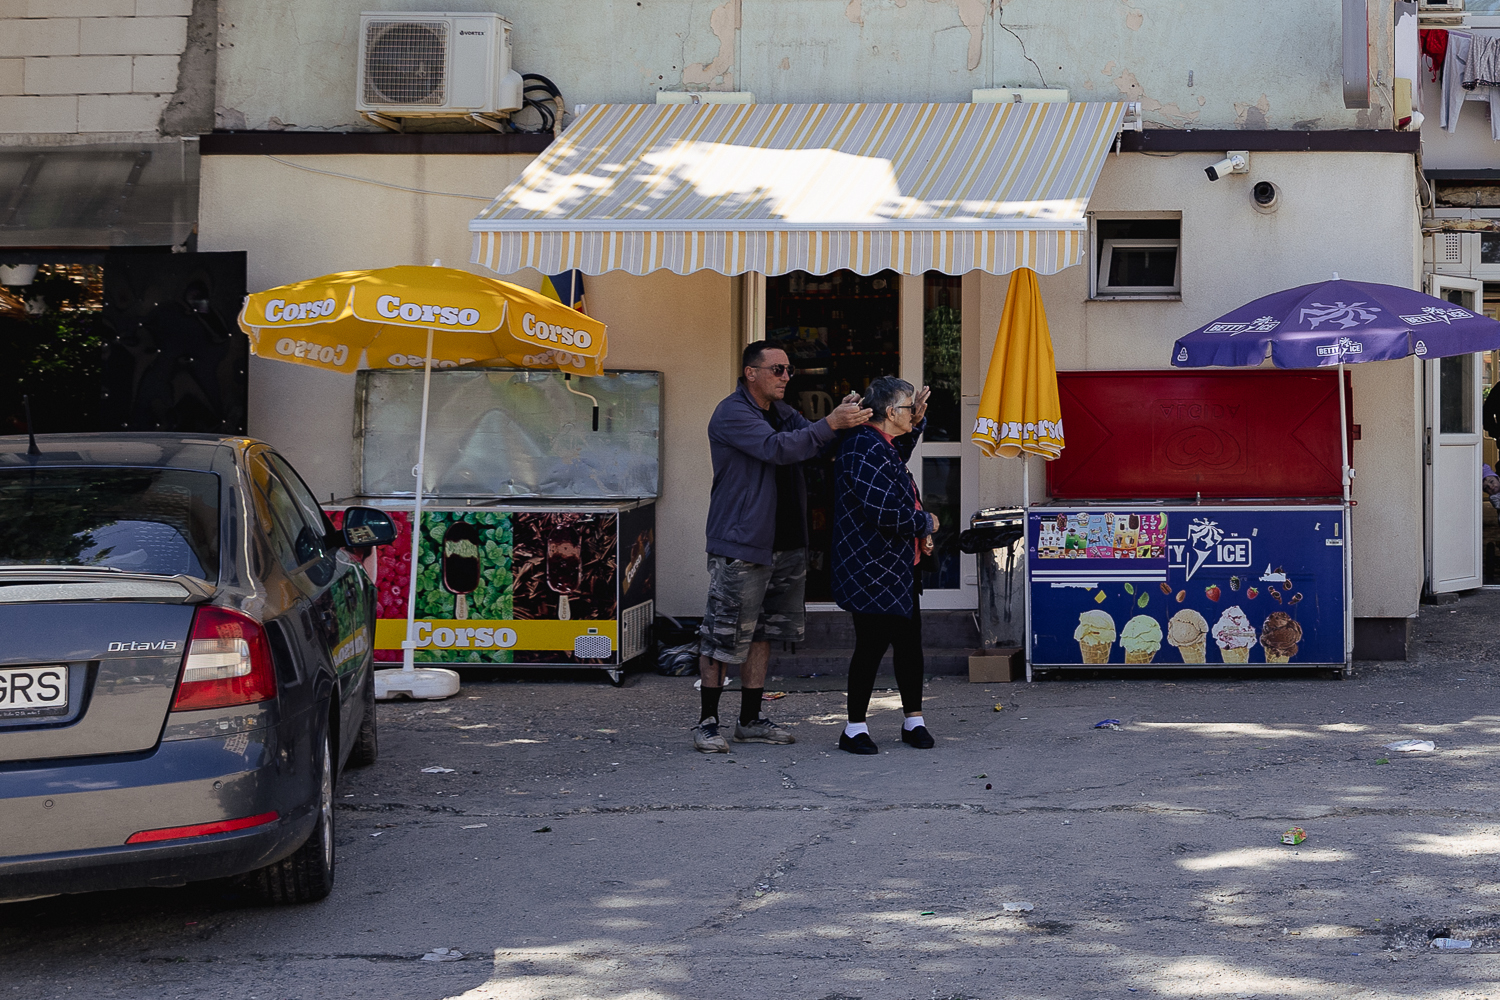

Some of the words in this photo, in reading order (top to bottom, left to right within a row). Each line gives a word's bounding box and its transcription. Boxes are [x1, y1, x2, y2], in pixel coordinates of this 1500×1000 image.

[265, 299, 336, 322] Corso
[376, 295, 480, 326] Corso
[522, 312, 592, 348] Corso
[1217, 544, 1246, 562] ICE
[627, 554, 642, 583] Corso
[107, 640, 177, 652] Octavia
[411, 621, 518, 648] Corso
